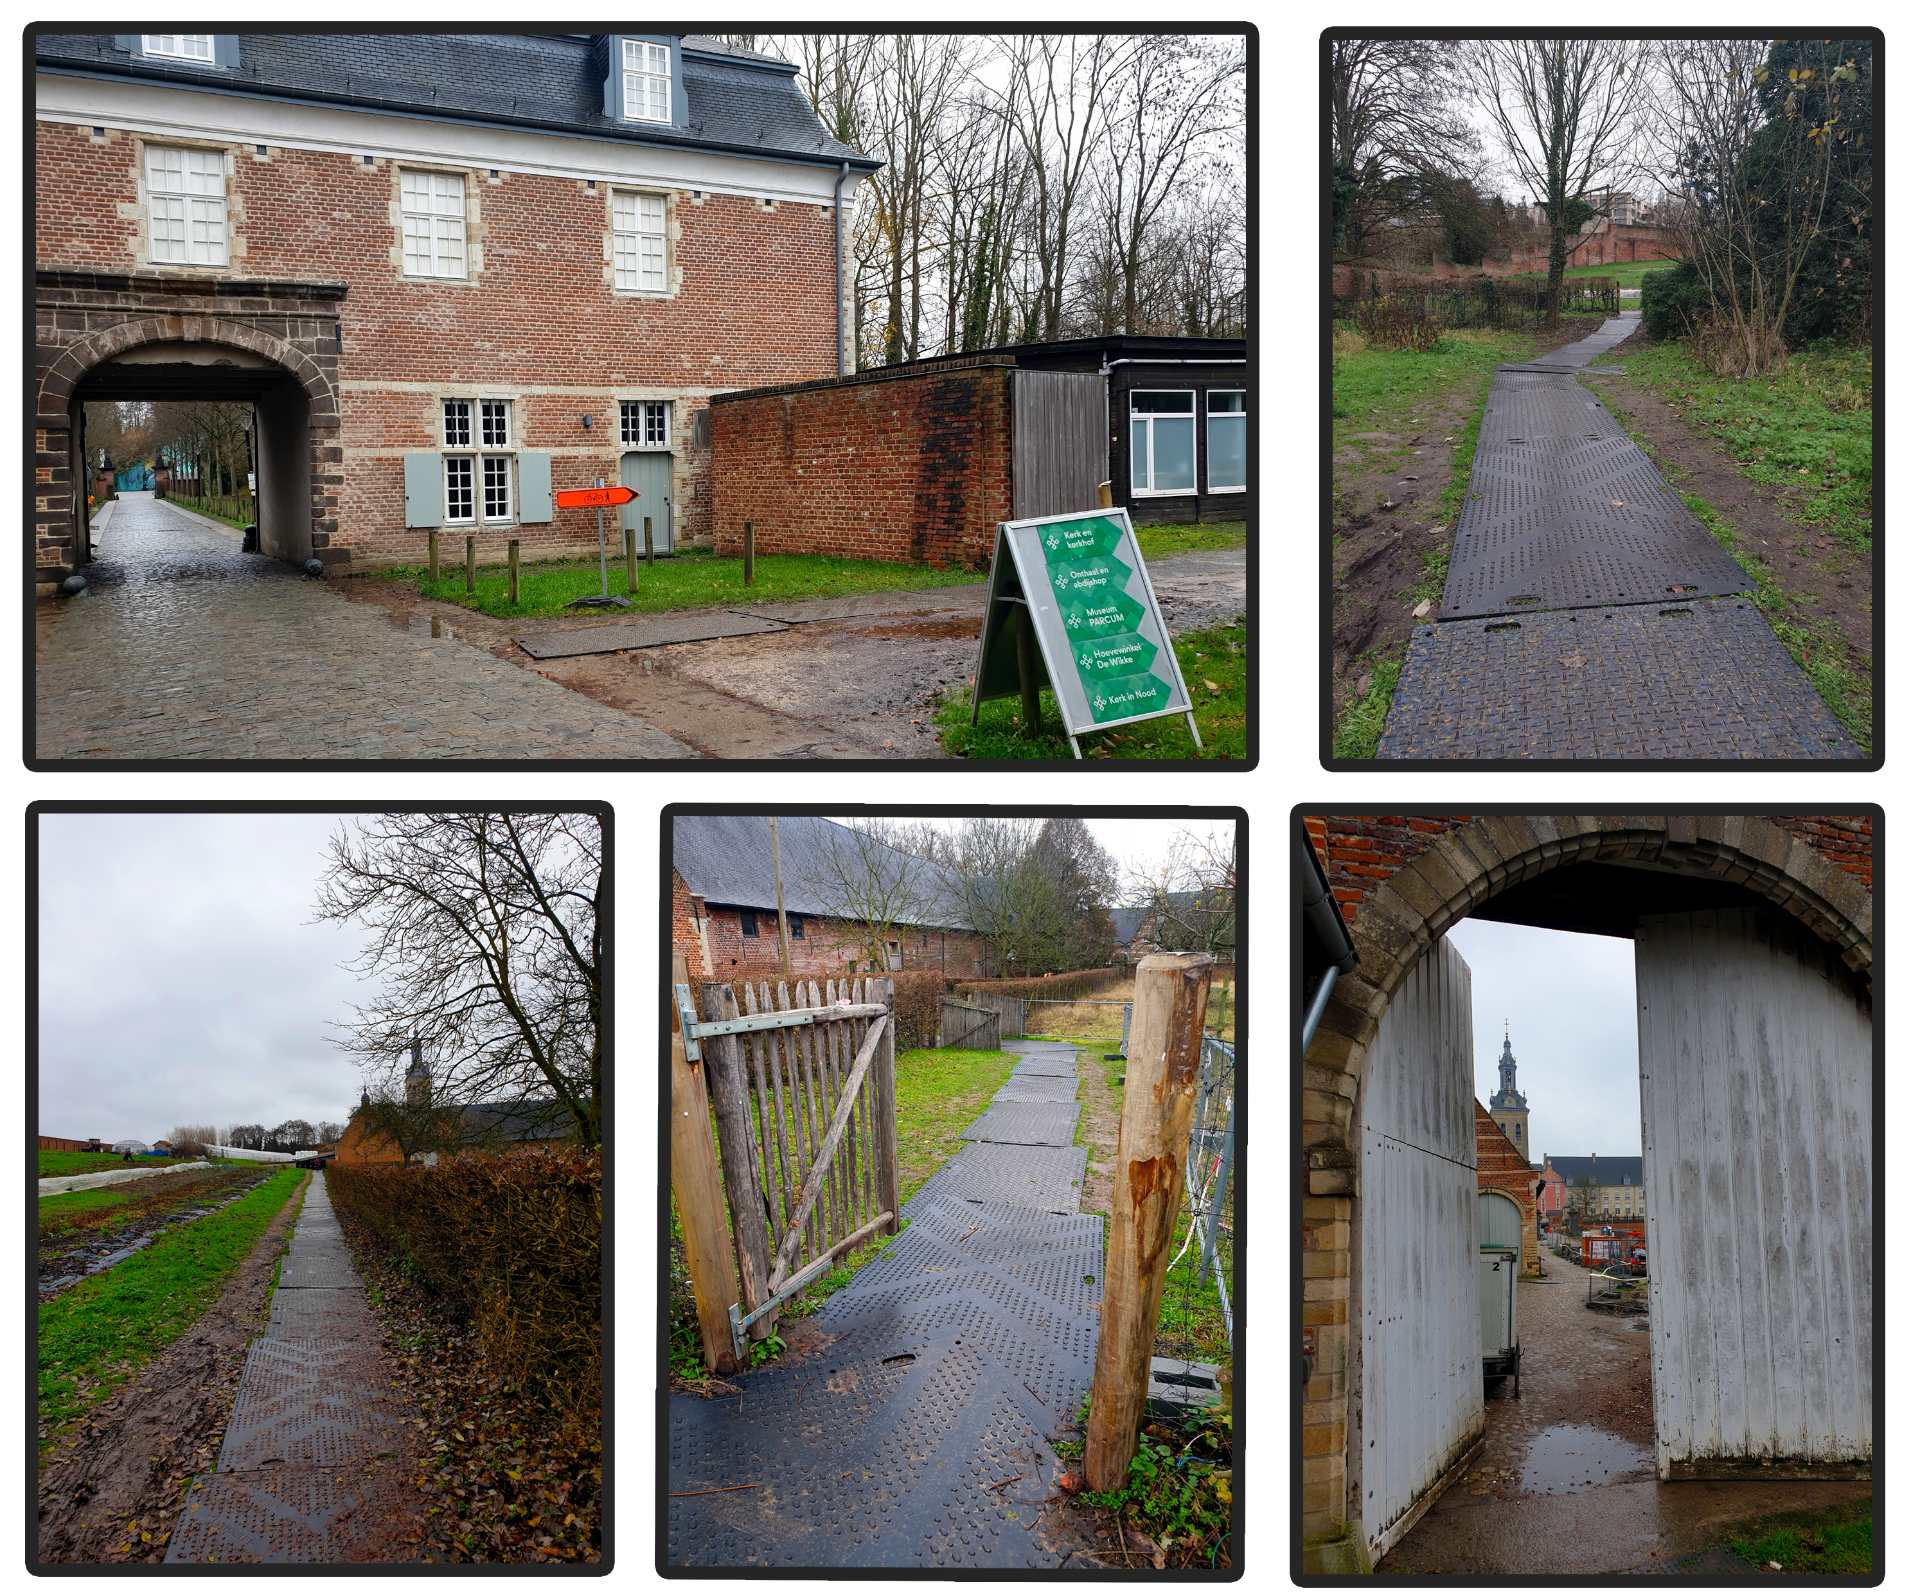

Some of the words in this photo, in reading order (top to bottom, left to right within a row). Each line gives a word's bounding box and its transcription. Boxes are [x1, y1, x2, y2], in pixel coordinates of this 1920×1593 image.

[1064, 530, 1082, 539] Kerk
[1066, 538, 1095, 548] kerkhof
[1070, 568, 1099, 578] Onthaal
[1074, 577, 1107, 588] abdijshop
[1086, 606, 1117, 616] Museum
[1089, 614, 1125, 626] PARCUM
[1093, 643, 1142, 658] Hoevewinkel
[1096, 660, 1109, 669] De
[1109, 656, 1133, 666] Wikke
[1108, 693, 1127, 704] Kerk
[1127, 692, 1135, 700] in
[1135, 688, 1157, 699] Nood
[1492, 1262, 1500, 1271] 2
